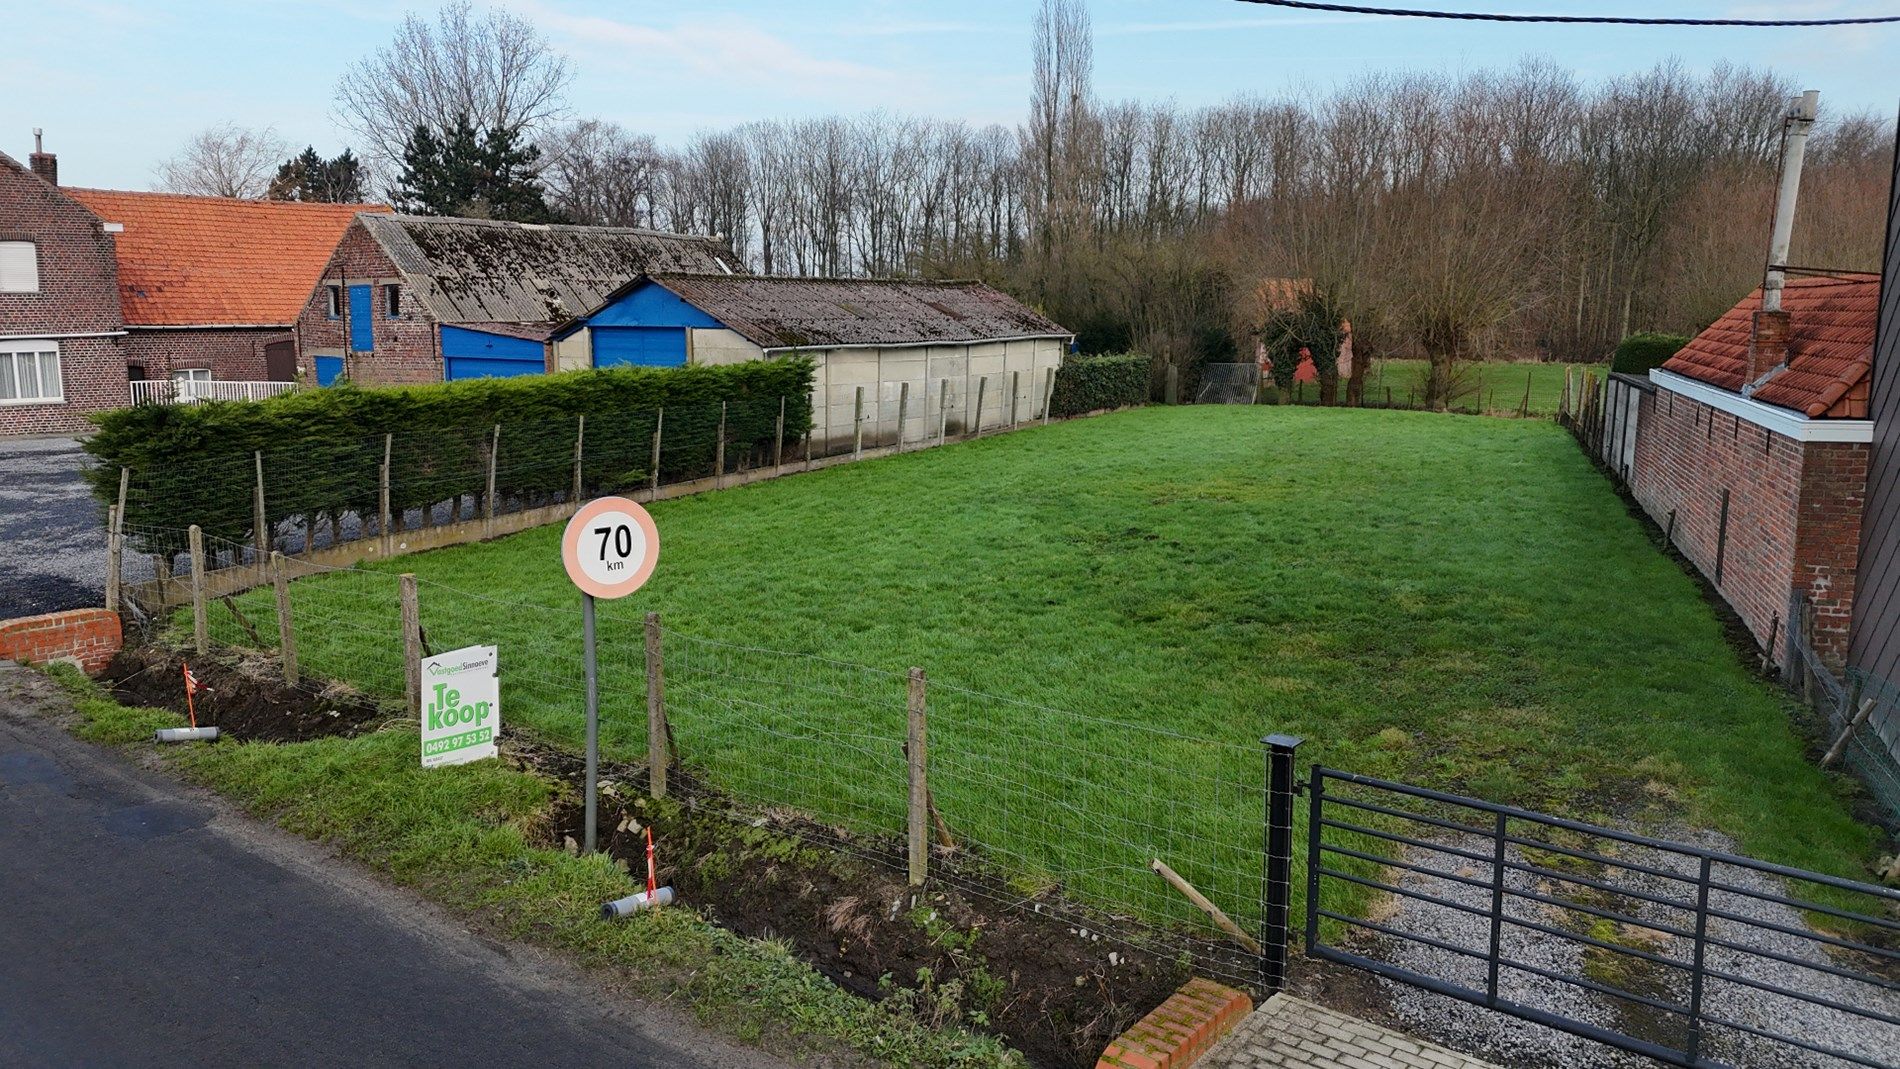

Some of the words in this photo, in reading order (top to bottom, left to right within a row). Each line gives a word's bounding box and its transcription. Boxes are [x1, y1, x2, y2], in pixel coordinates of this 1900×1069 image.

[594, 524, 632, 561] 70
[606, 561, 624, 571] km
[432, 683, 460, 710] Te
[428, 701, 490, 731] koop
[426, 739, 450, 754] 0492
[452, 736, 464, 747] 97
[465, 734, 477, 745] 53
[479, 729, 490, 741] 52
